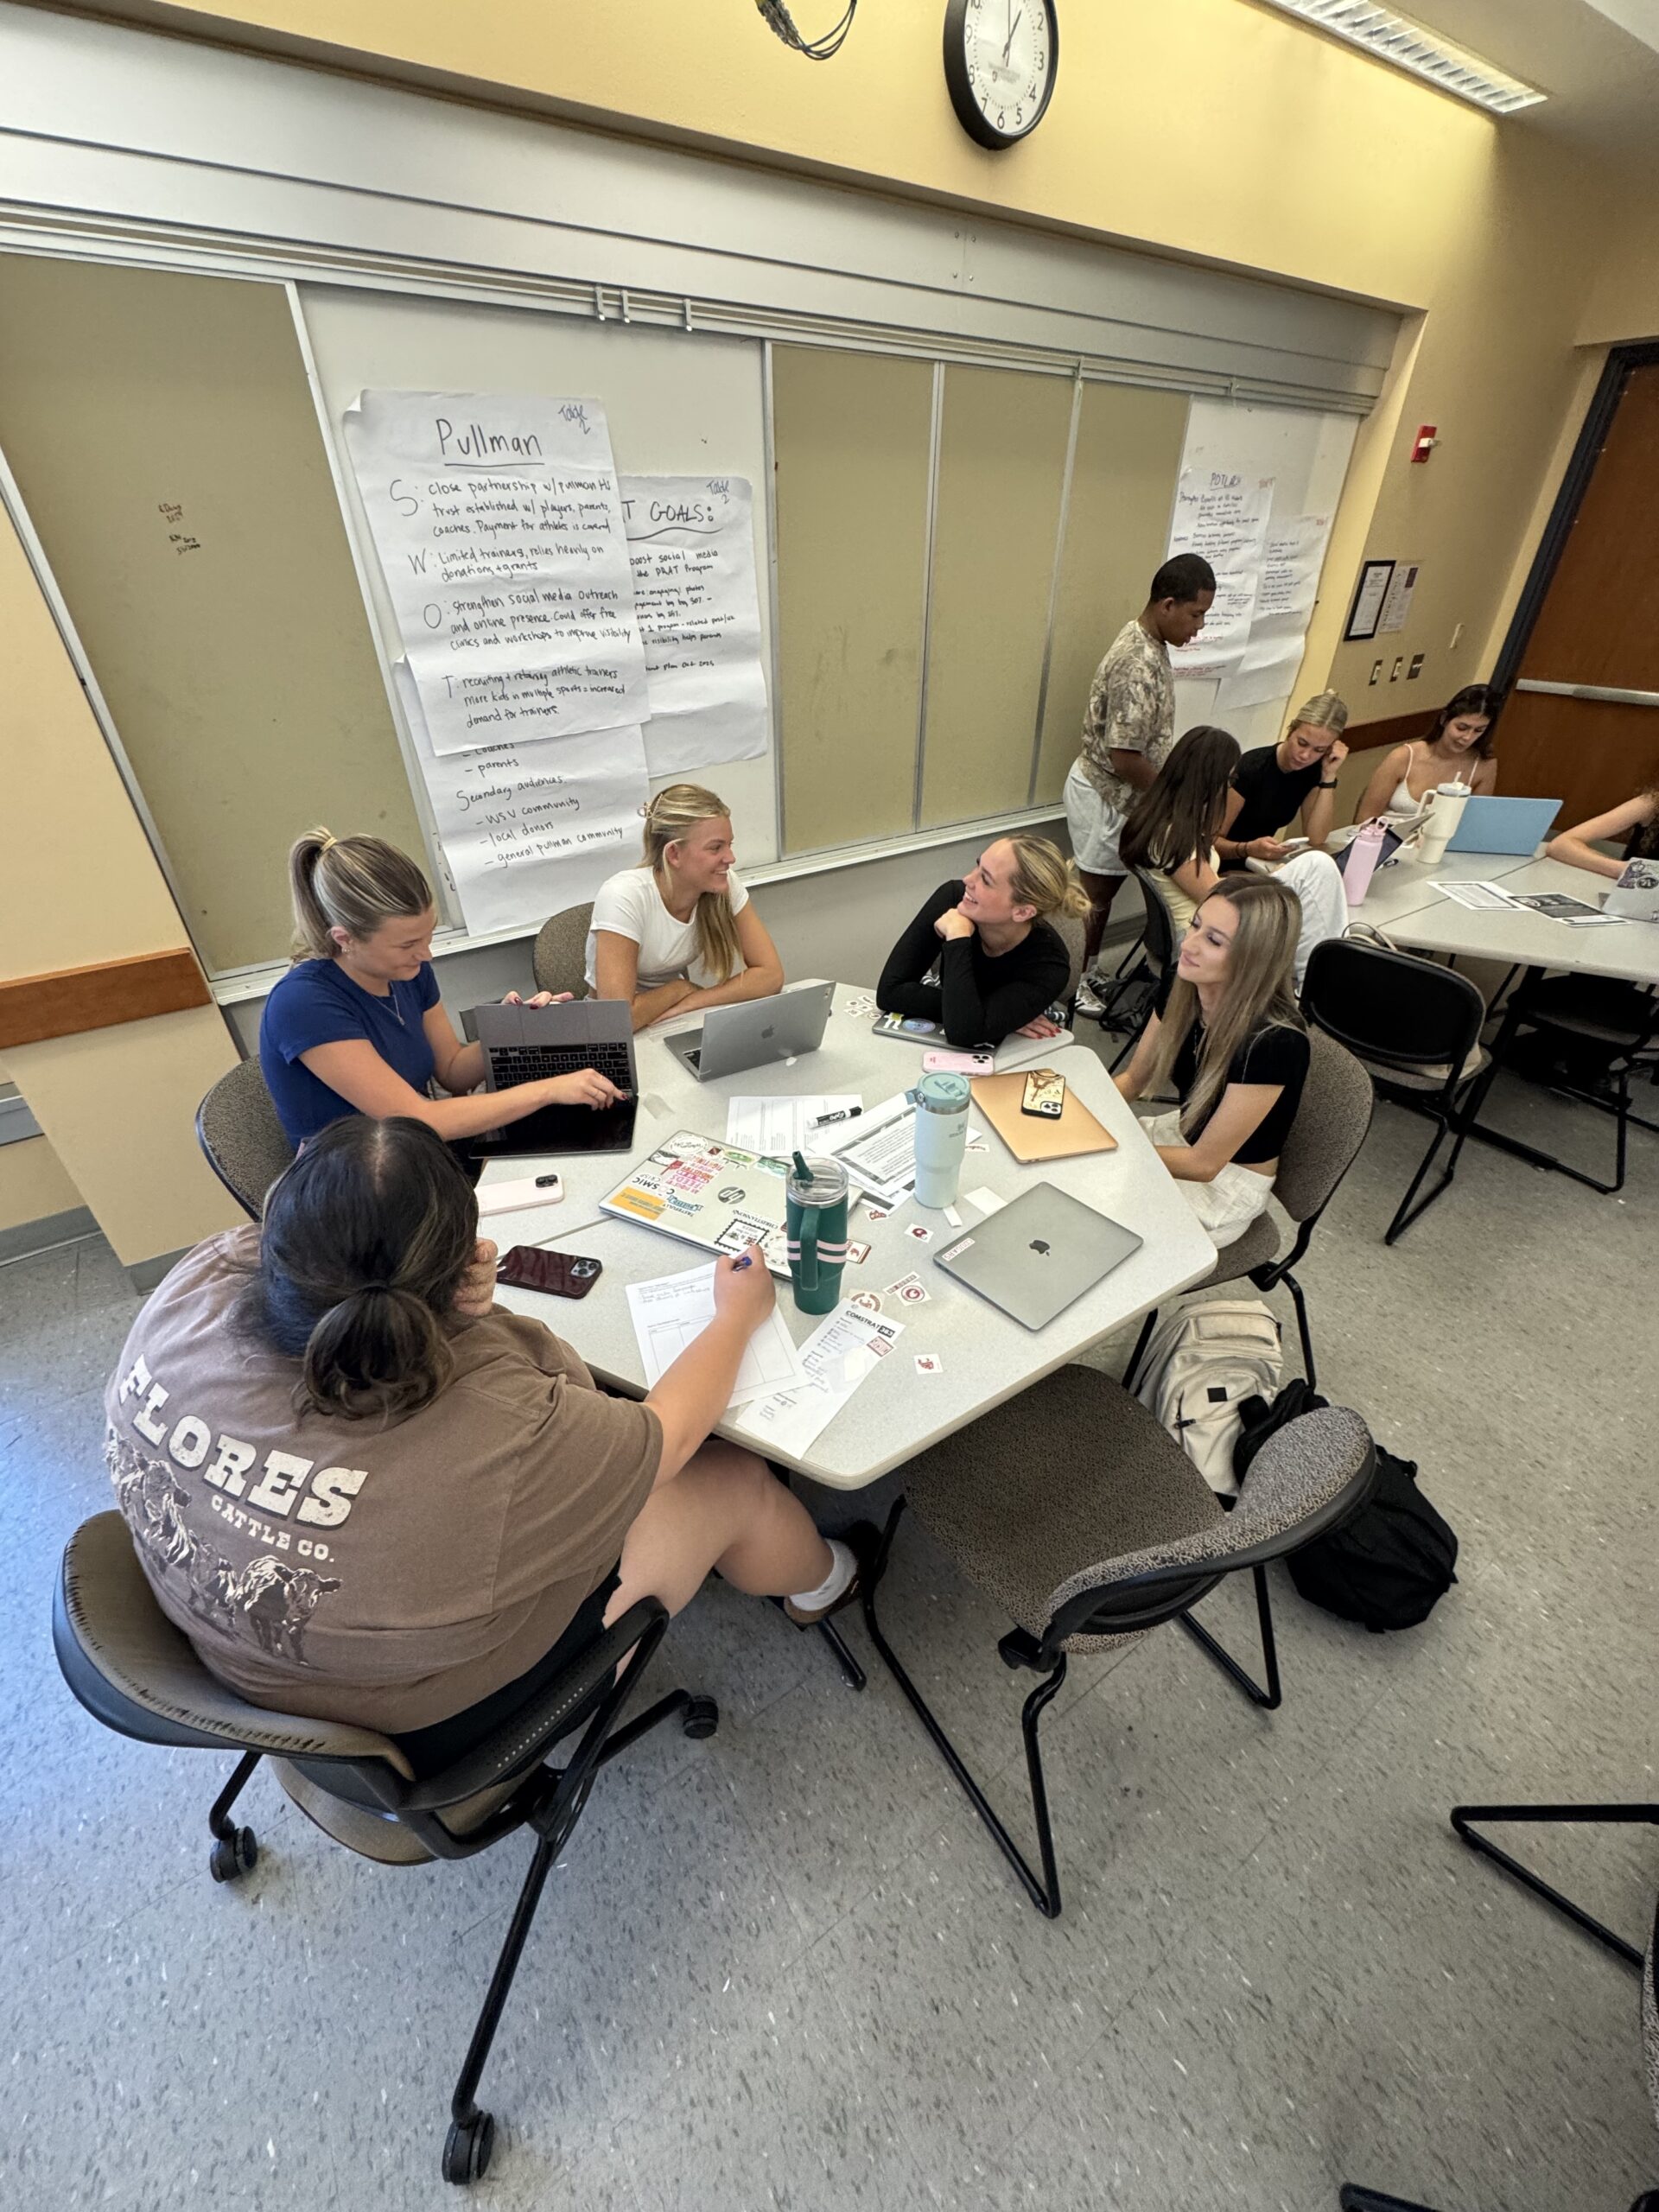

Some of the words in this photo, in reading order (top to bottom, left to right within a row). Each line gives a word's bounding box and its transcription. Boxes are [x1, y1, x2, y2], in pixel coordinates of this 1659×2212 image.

[1037, 12, 1044, 30] 2
[965, 24, 973, 44] 9
[1038, 51, 1045, 71] 3
[969, 65, 975, 86] 8
[1029, 84, 1036, 102] 4
[982, 97, 988, 115] 7
[997, 111, 1005, 130] 6
[1015, 108, 1022, 125] 5
[435, 419, 542, 457] Pullman
[469, 478, 537, 499] partnership
[433, 504, 460, 517] trust
[467, 500, 518, 513] established
[650, 501, 714, 522] GOALS:
[476, 519, 518, 538] Payment
[521, 518, 534, 531] for
[539, 519, 569, 531] athletes
[582, 518, 611, 534] covered
[439, 547, 477, 564] Limited
[531, 546, 553, 556] relies
[592, 545, 604, 554] on
[658, 550, 685, 562] social
[696, 550, 718, 560] media
[442, 564, 493, 582] donations
[637, 569, 649, 577] the
[656, 566, 678, 576] PRAT
[542, 591, 572, 602] media
[451, 619, 470, 635] and
[474, 617, 506, 631] online
[580, 607, 596, 620] offer
[601, 607, 617, 619] free
[484, 634, 500, 645] and
[505, 632, 552, 644] workshops
[555, 629, 563, 638] to
[567, 629, 598, 642] improve
[551, 664, 582, 677] athletic
[586, 665, 619, 679] trainers
[493, 691, 509, 702] kids
[556, 683, 582, 696] sports
[590, 684, 626, 695] increased
[467, 708, 502, 729] demand
[505, 708, 517, 720] for
[478, 757, 519, 778] parents
[456, 785, 512, 811] Secondary
[522, 798, 581, 817] community
[488, 829, 517, 847] local
[522, 821, 554, 836] donors
[497, 848, 534, 868] general
[577, 826, 623, 843] community
[845, 1310, 880, 1329] COMSTRAT
[119, 1353, 369, 1529] FLORES
[211, 1493, 290, 1550] CATTLE
[297, 1539, 335, 1563] CO.
